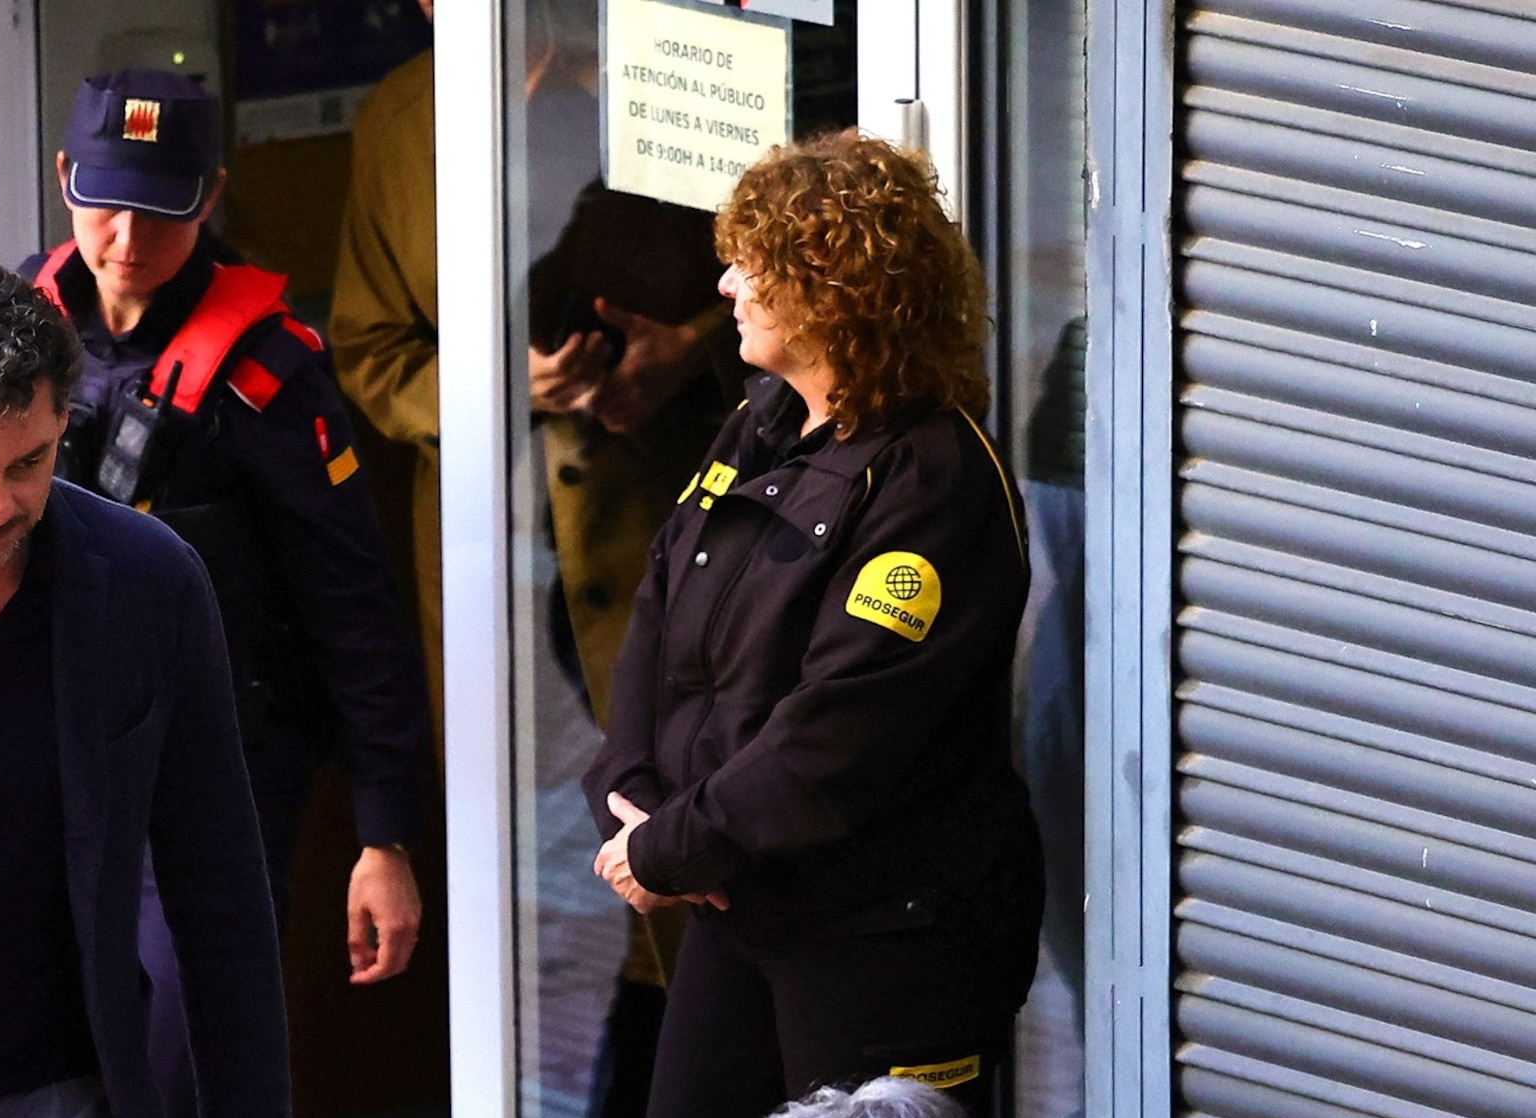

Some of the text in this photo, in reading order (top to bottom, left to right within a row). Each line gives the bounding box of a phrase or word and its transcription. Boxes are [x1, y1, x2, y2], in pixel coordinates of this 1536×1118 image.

[654, 38, 733, 70] HORARIO DE
[623, 64, 764, 110] ATENCIÓN AL PÚBLICO
[629, 100, 759, 146] DE LUNES A VIERNES
[637, 139, 654, 157] DE
[656, 143, 692, 166] 9:00H
[697, 153, 704, 169] A
[854, 594, 925, 632] PROSEGUR
